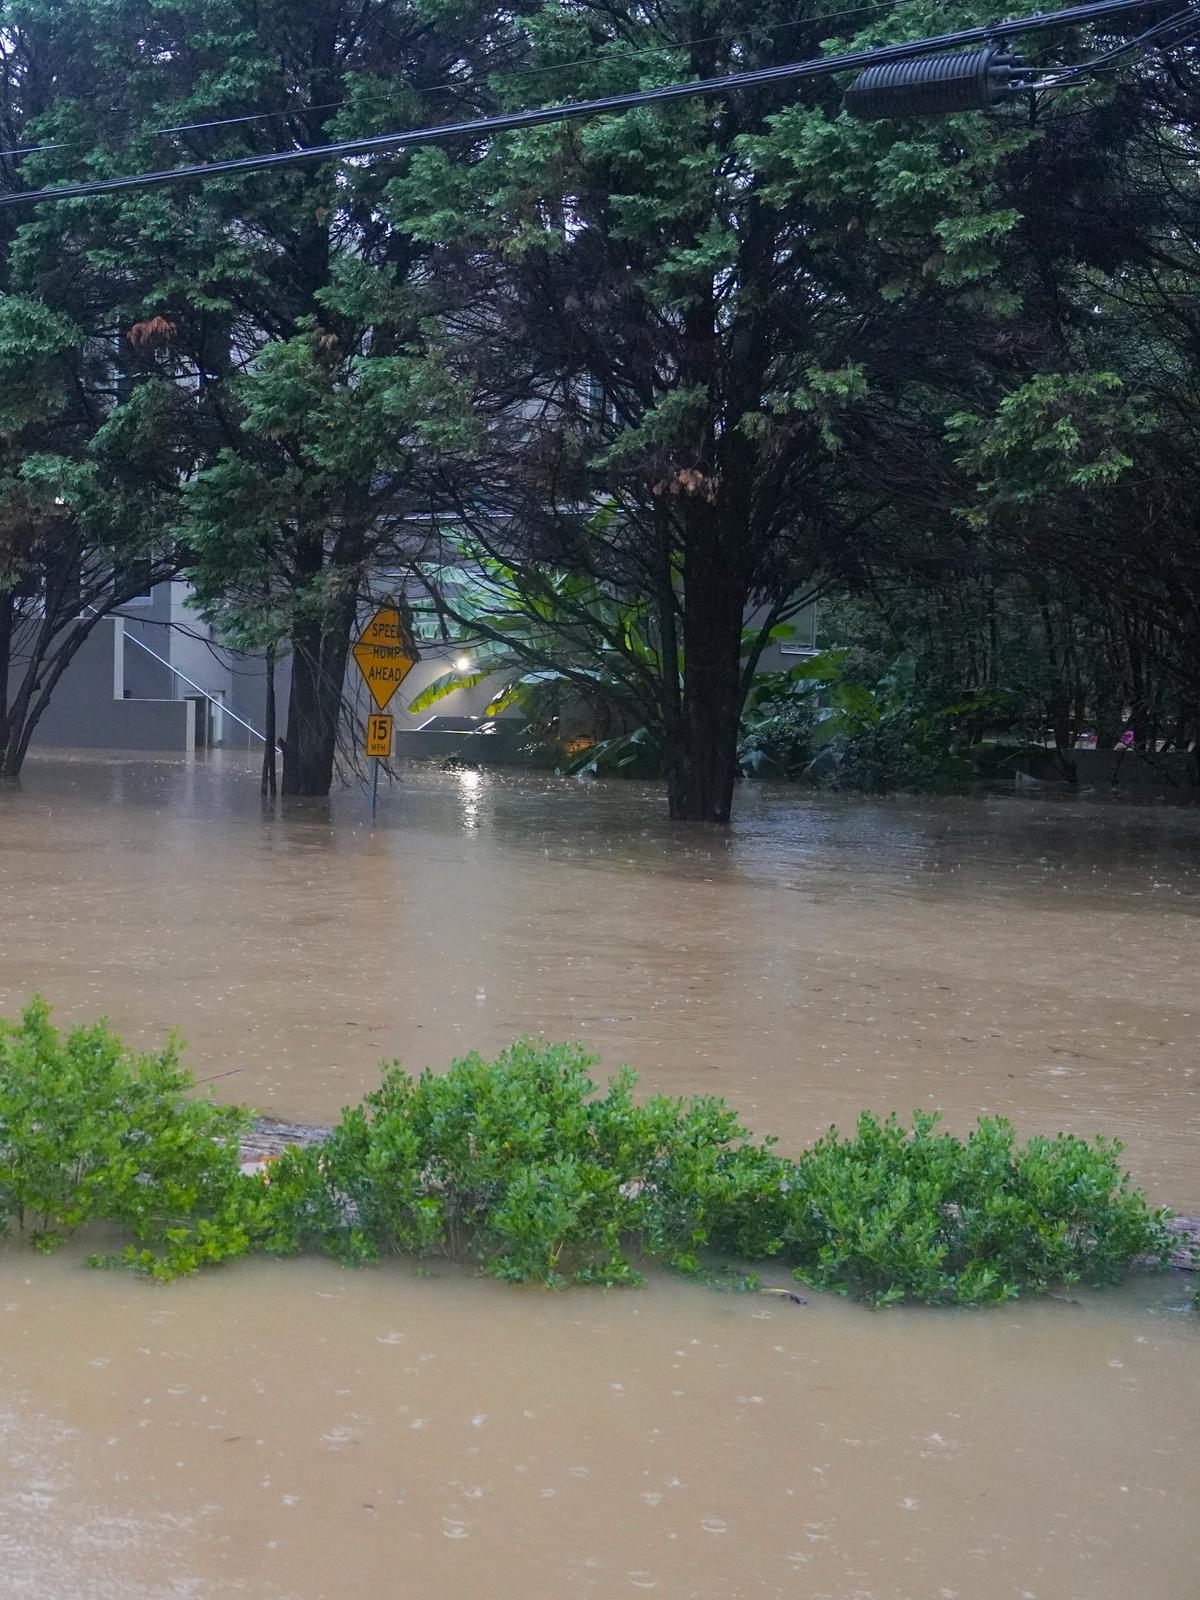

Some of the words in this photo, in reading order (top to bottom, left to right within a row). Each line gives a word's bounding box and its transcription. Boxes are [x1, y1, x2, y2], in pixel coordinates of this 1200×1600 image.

[373, 645, 400, 659] HUMP
[368, 666, 401, 681] AHEAD
[372, 719, 387, 740] 15
[371, 743, 386, 752] MPH
